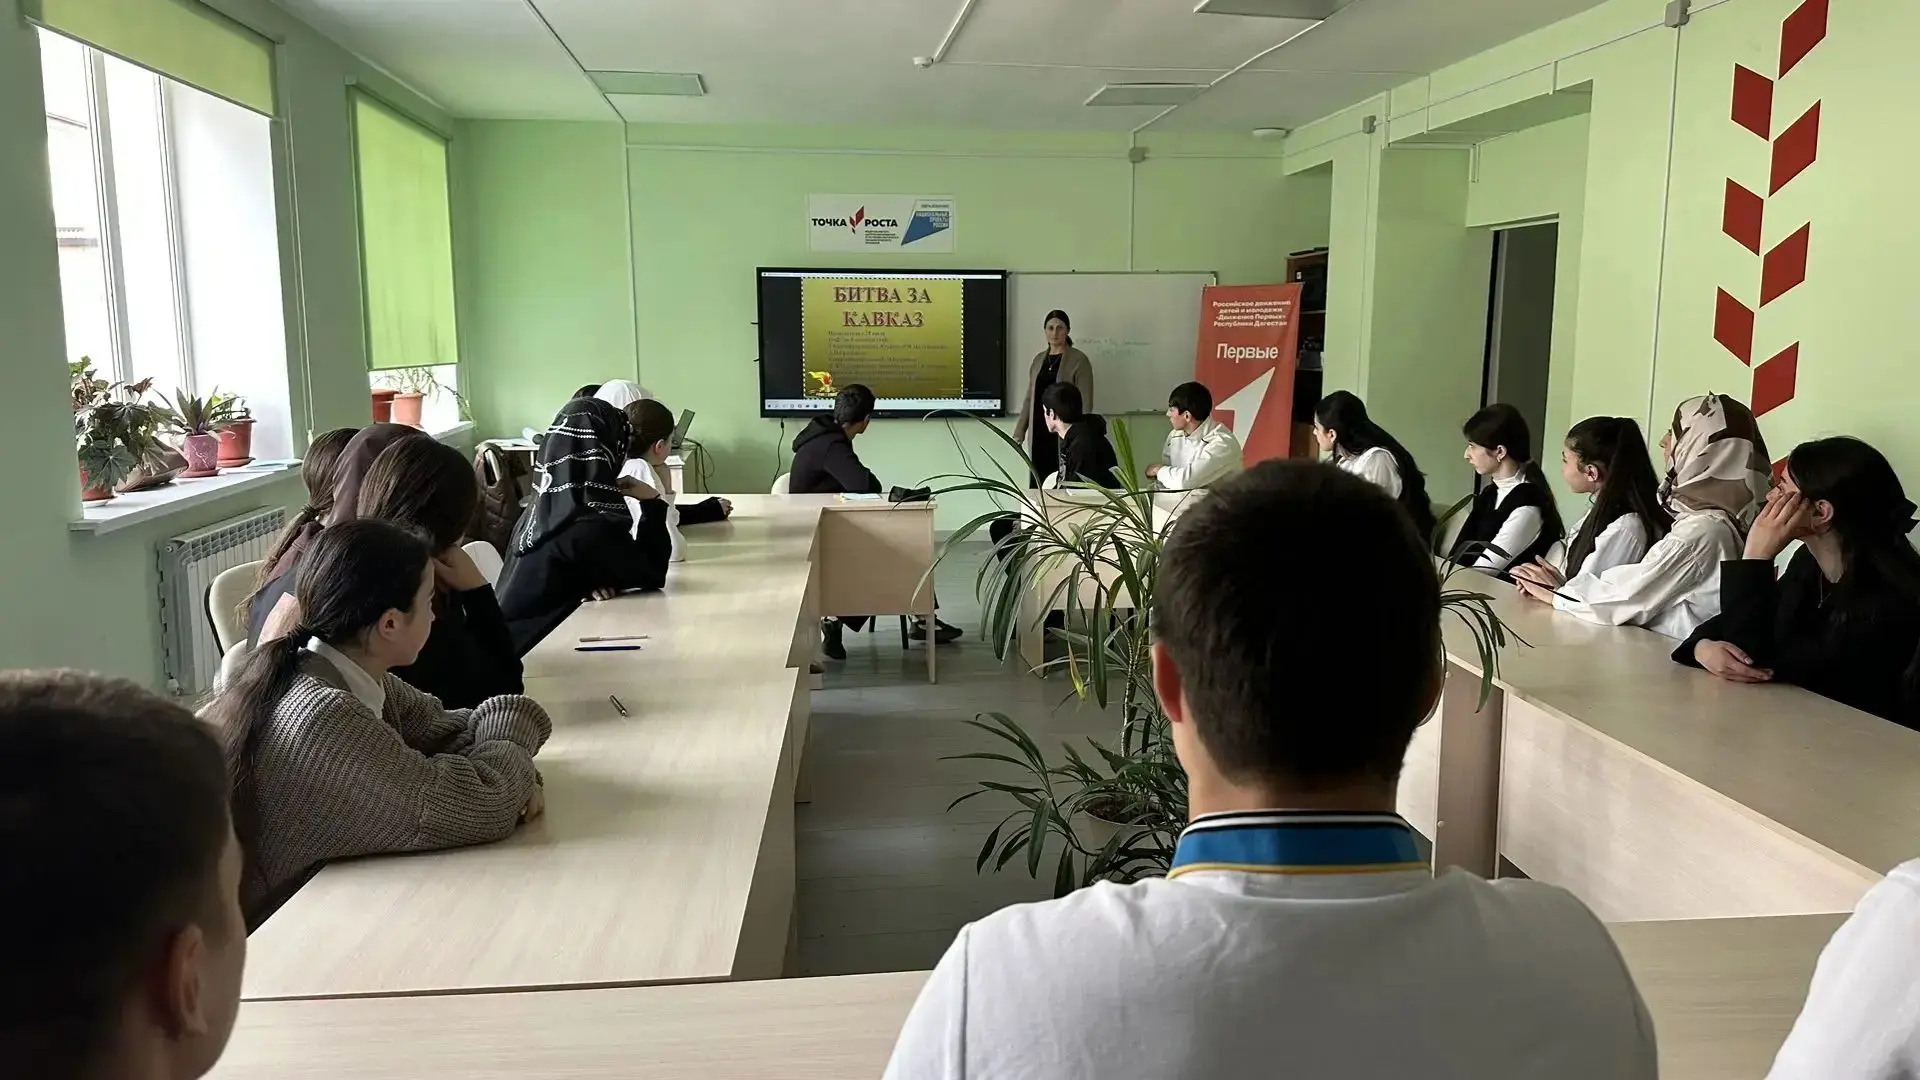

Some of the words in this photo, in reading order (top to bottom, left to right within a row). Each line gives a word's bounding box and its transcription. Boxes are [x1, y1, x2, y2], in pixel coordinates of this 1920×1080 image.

[811, 218, 847, 227] ТОЧКА
[864, 219, 898, 227] РОСТА
[833, 286, 902, 304] БИТВА
[906, 287, 932, 304] ЗА
[842, 311, 924, 328] КАВКАЗ
[1217, 343, 1278, 363] Первые
